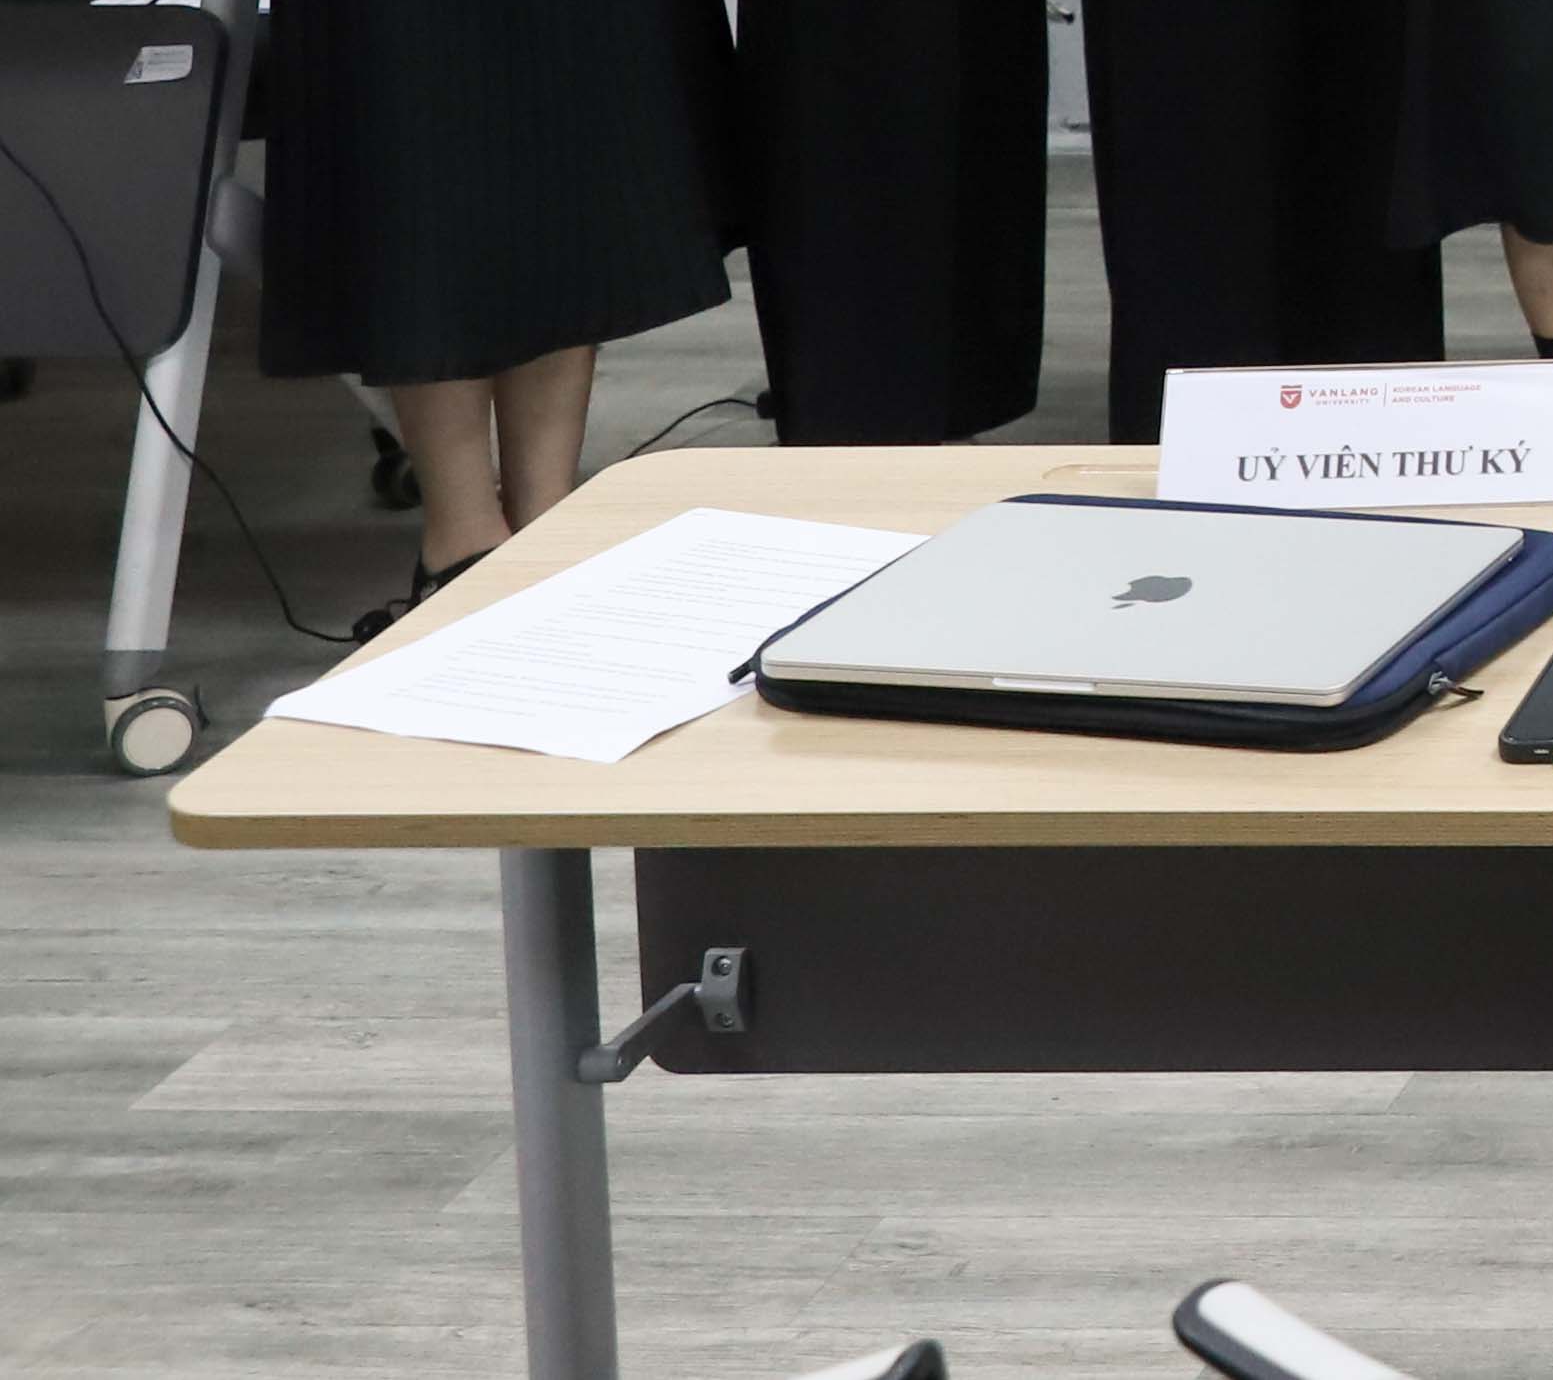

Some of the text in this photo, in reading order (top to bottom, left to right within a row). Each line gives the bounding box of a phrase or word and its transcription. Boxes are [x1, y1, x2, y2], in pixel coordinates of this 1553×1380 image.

[1309, 387, 1379, 398] VANLANG
[1237, 440, 1532, 482] UỶ VIÊN THƯ KÝ
